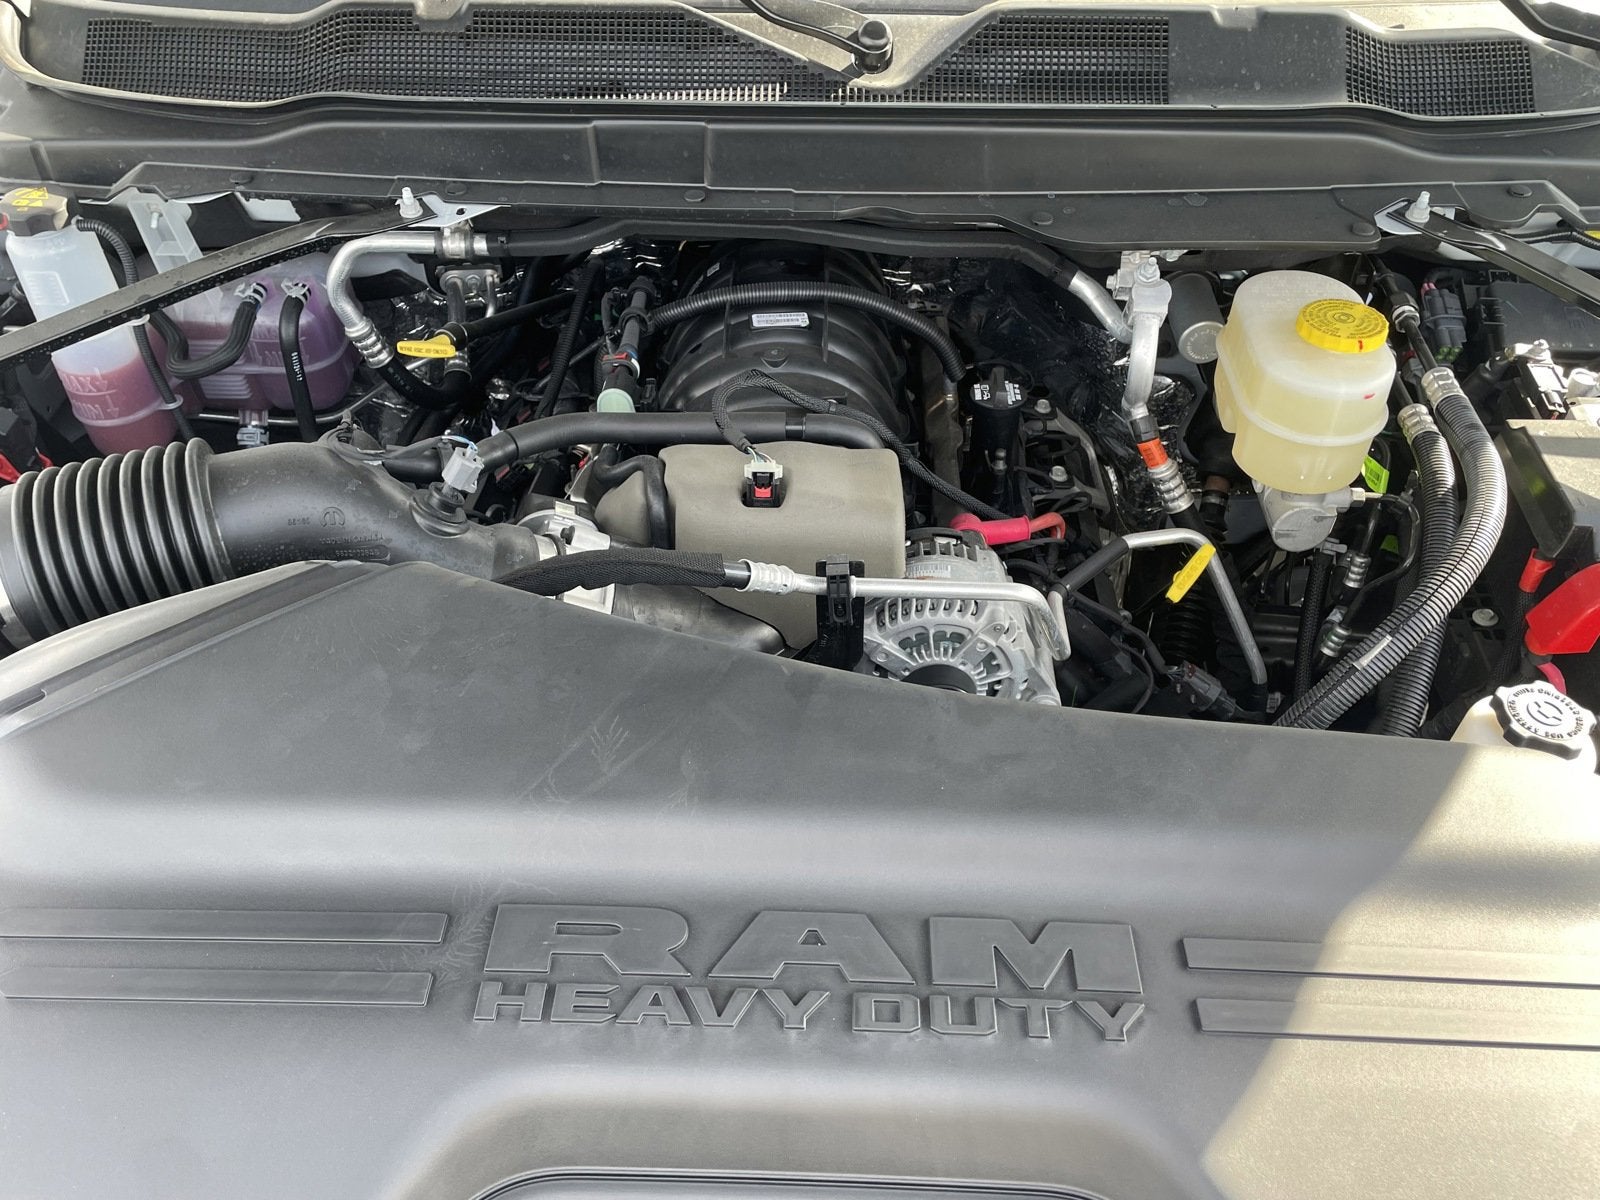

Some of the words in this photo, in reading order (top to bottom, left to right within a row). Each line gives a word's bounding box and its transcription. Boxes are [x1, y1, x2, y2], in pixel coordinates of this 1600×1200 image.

[484, 903, 1143, 994] RAM
[473, 981, 830, 1030] HEAVY
[852, 991, 1145, 1043] DUTY
